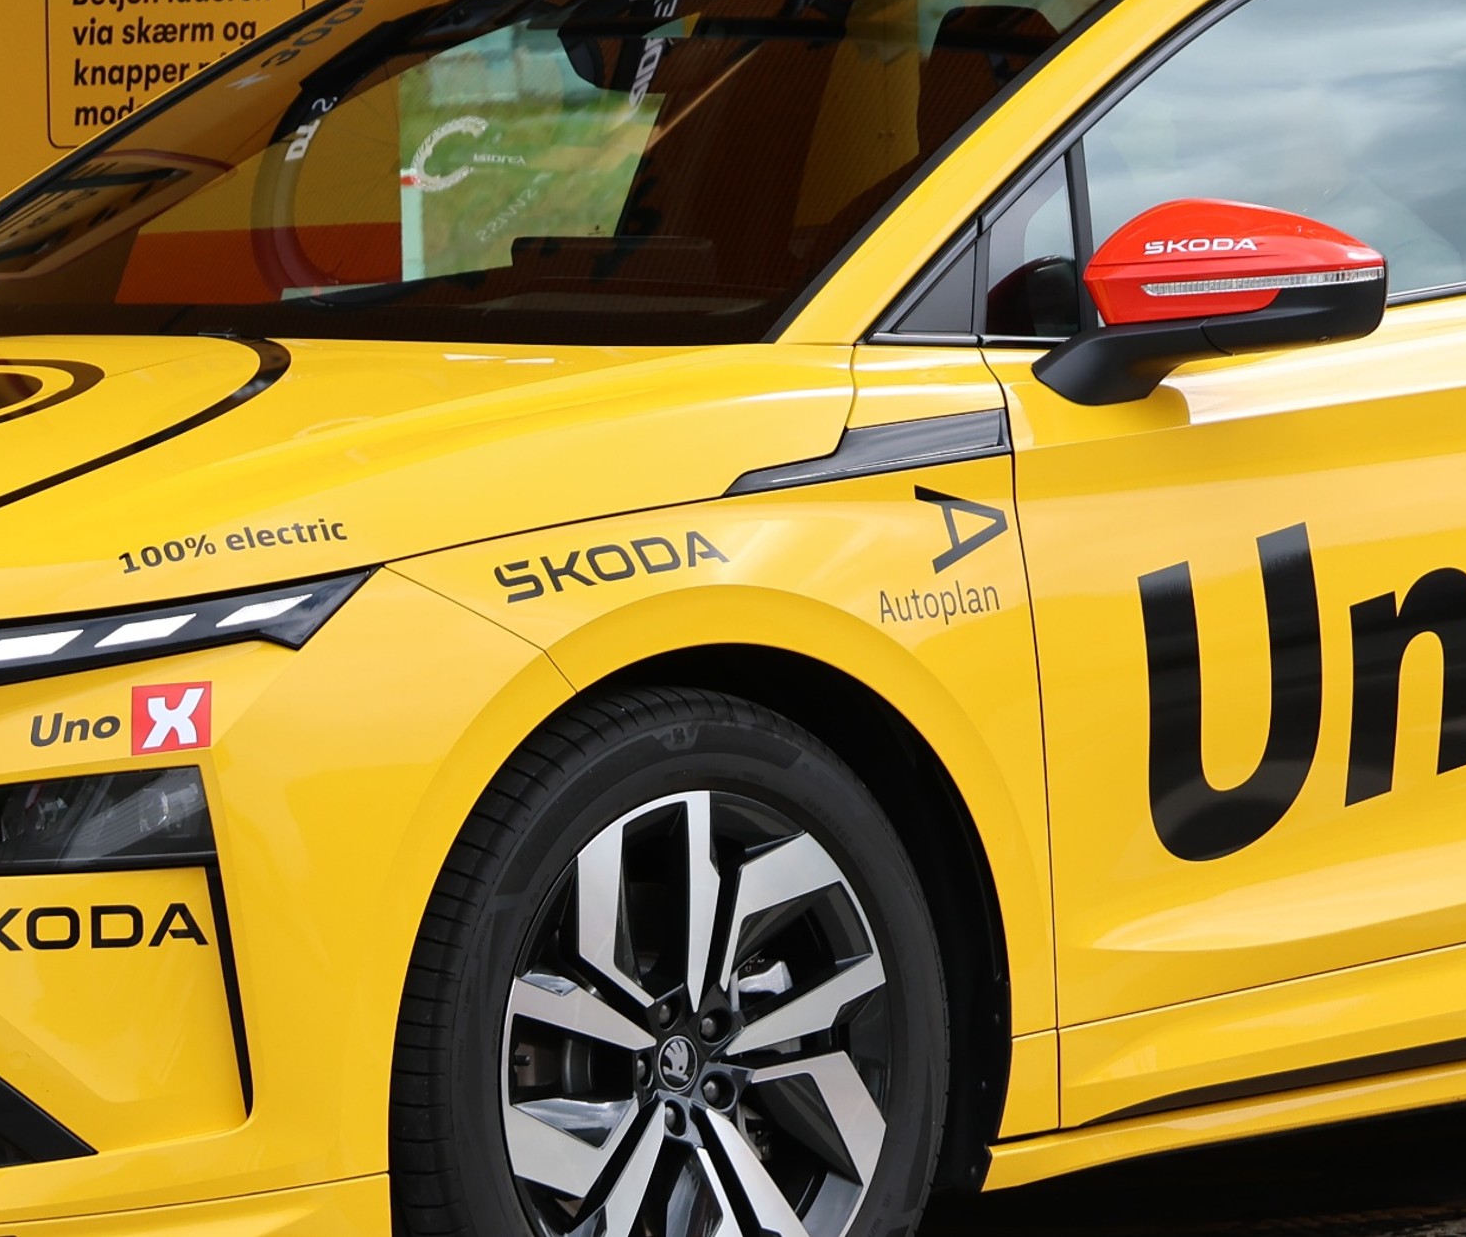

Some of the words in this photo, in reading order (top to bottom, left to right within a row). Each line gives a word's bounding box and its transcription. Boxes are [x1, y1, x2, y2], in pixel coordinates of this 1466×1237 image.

[72, 17, 114, 46] via
[121, 15, 216, 45] skærm
[73, 58, 189, 91] knapper
[117, 534, 218, 576] 100%
[223, 515, 349, 555] electric
[879, 579, 1001, 626] Autoplan
[30, 711, 122, 748] Uno
[141, 687, 206, 750] X
